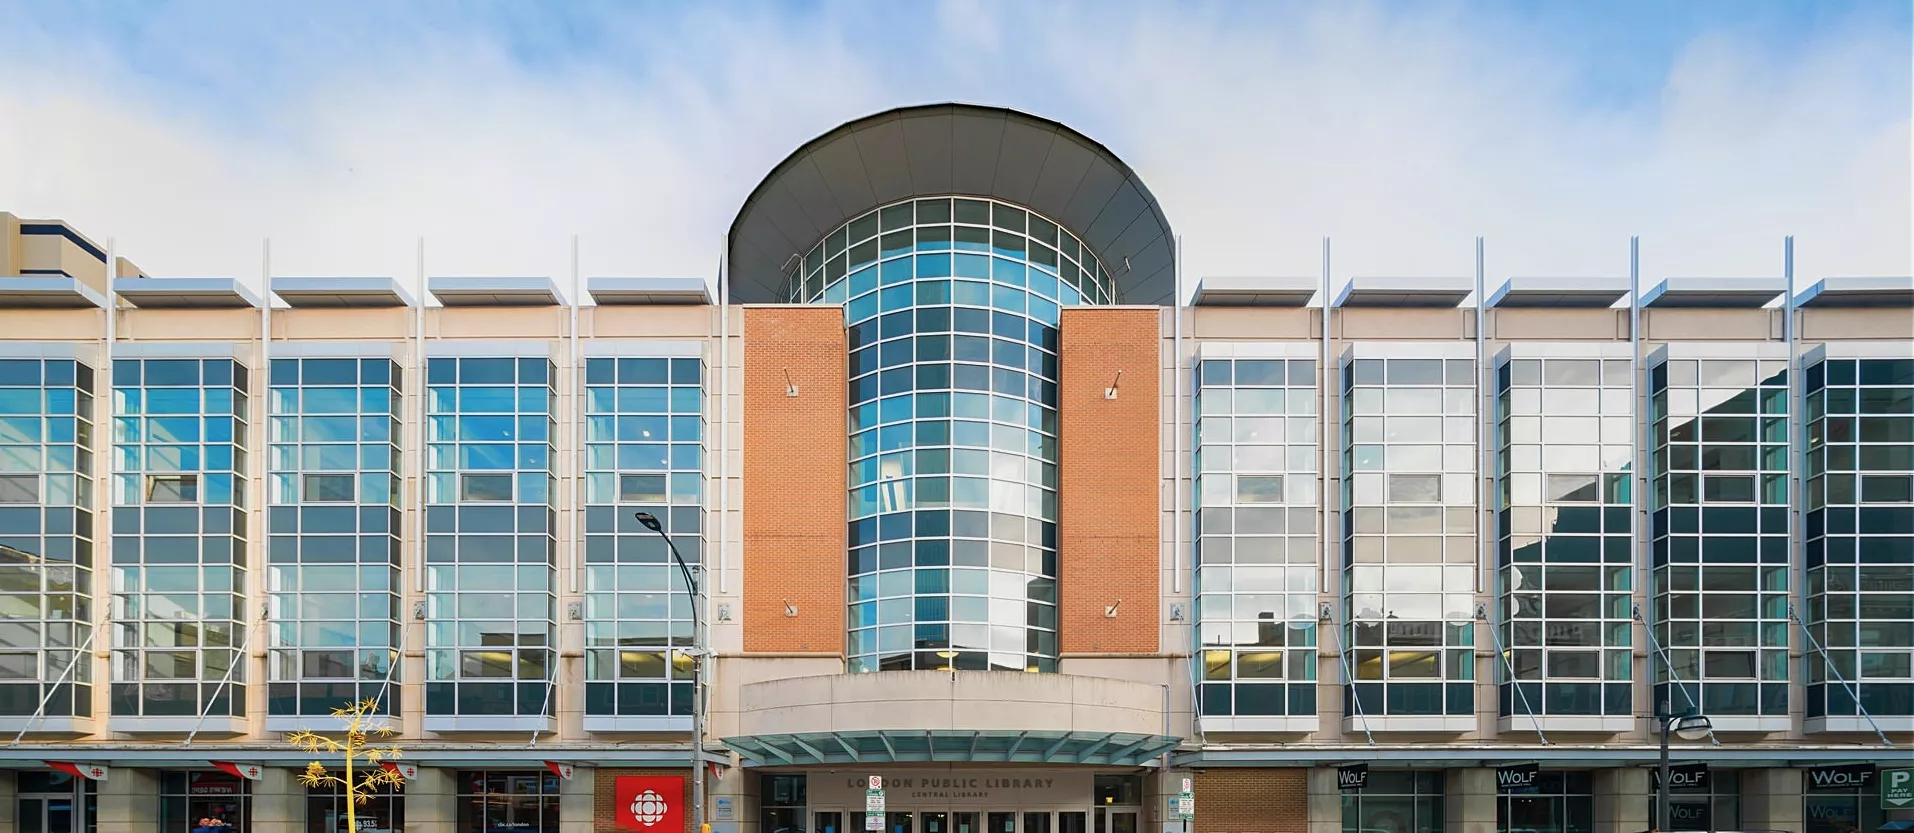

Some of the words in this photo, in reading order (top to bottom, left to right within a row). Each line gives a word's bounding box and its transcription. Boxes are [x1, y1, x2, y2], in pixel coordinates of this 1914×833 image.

[847, 779, 912, 788] LODON
[921, 779, 978, 788] PUBLIC
[985, 779, 1054, 788] LIBRARY
[1891, 772, 1910, 788] P
